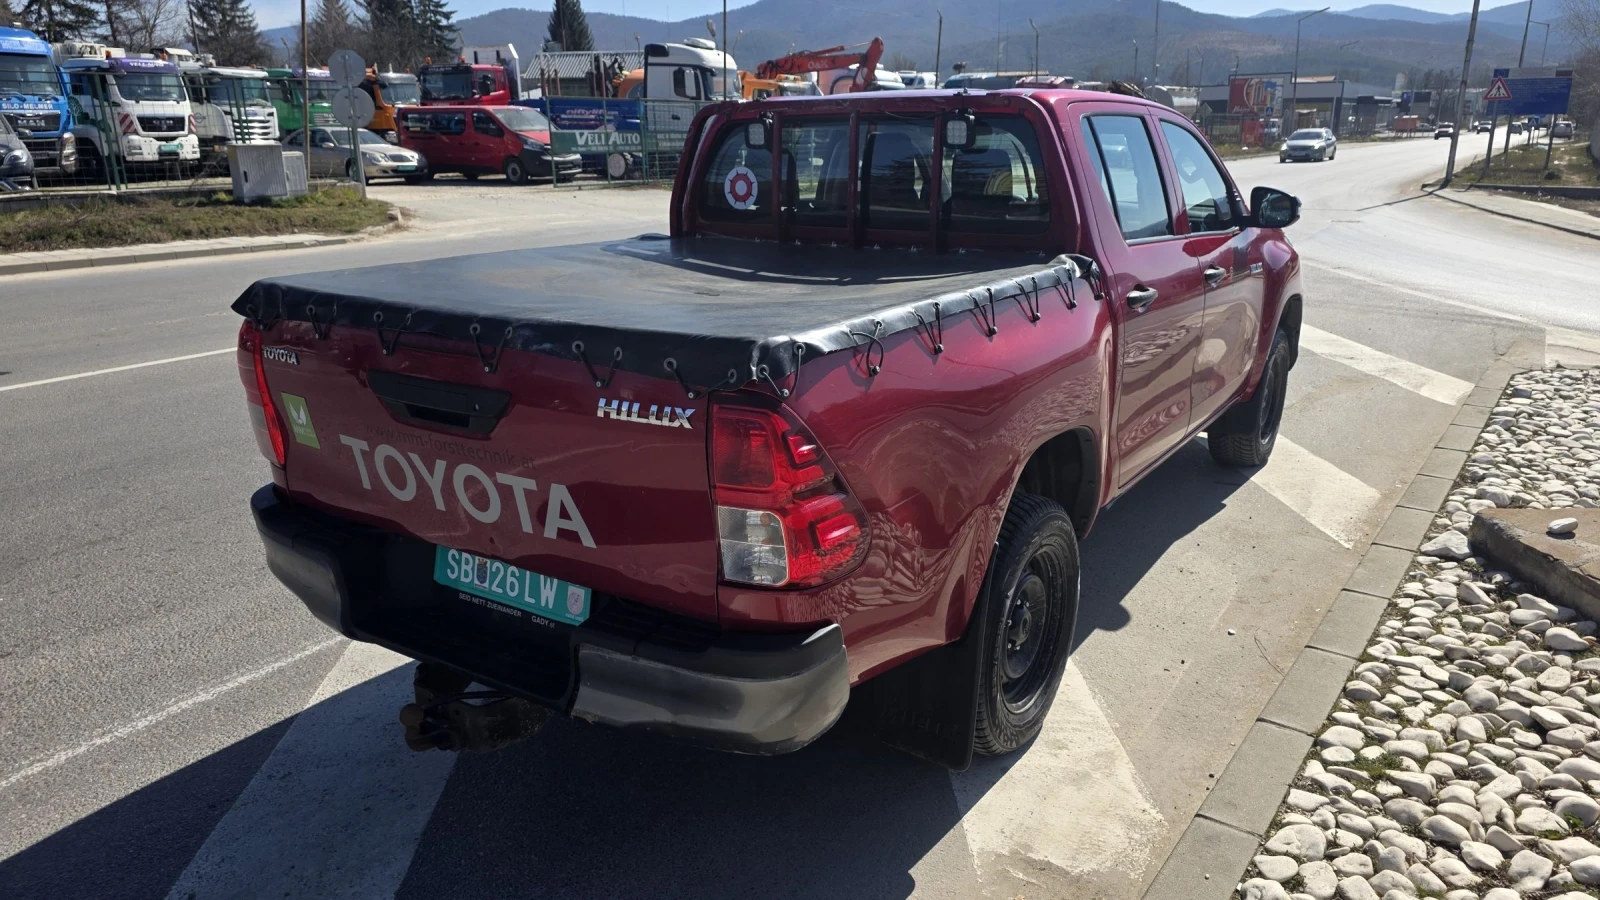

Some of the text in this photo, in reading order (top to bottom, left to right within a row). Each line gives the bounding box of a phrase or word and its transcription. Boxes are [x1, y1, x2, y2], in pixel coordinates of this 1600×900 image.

[575, 132, 640, 145] VELI AUTO
[264, 347, 298, 366] TOYOTA
[597, 398, 696, 429] HILUX
[364, 423, 536, 470] www.mm-forsttechnik.at
[338, 434, 597, 548] TOYOTA
[472, 596, 486, 607] NETT
